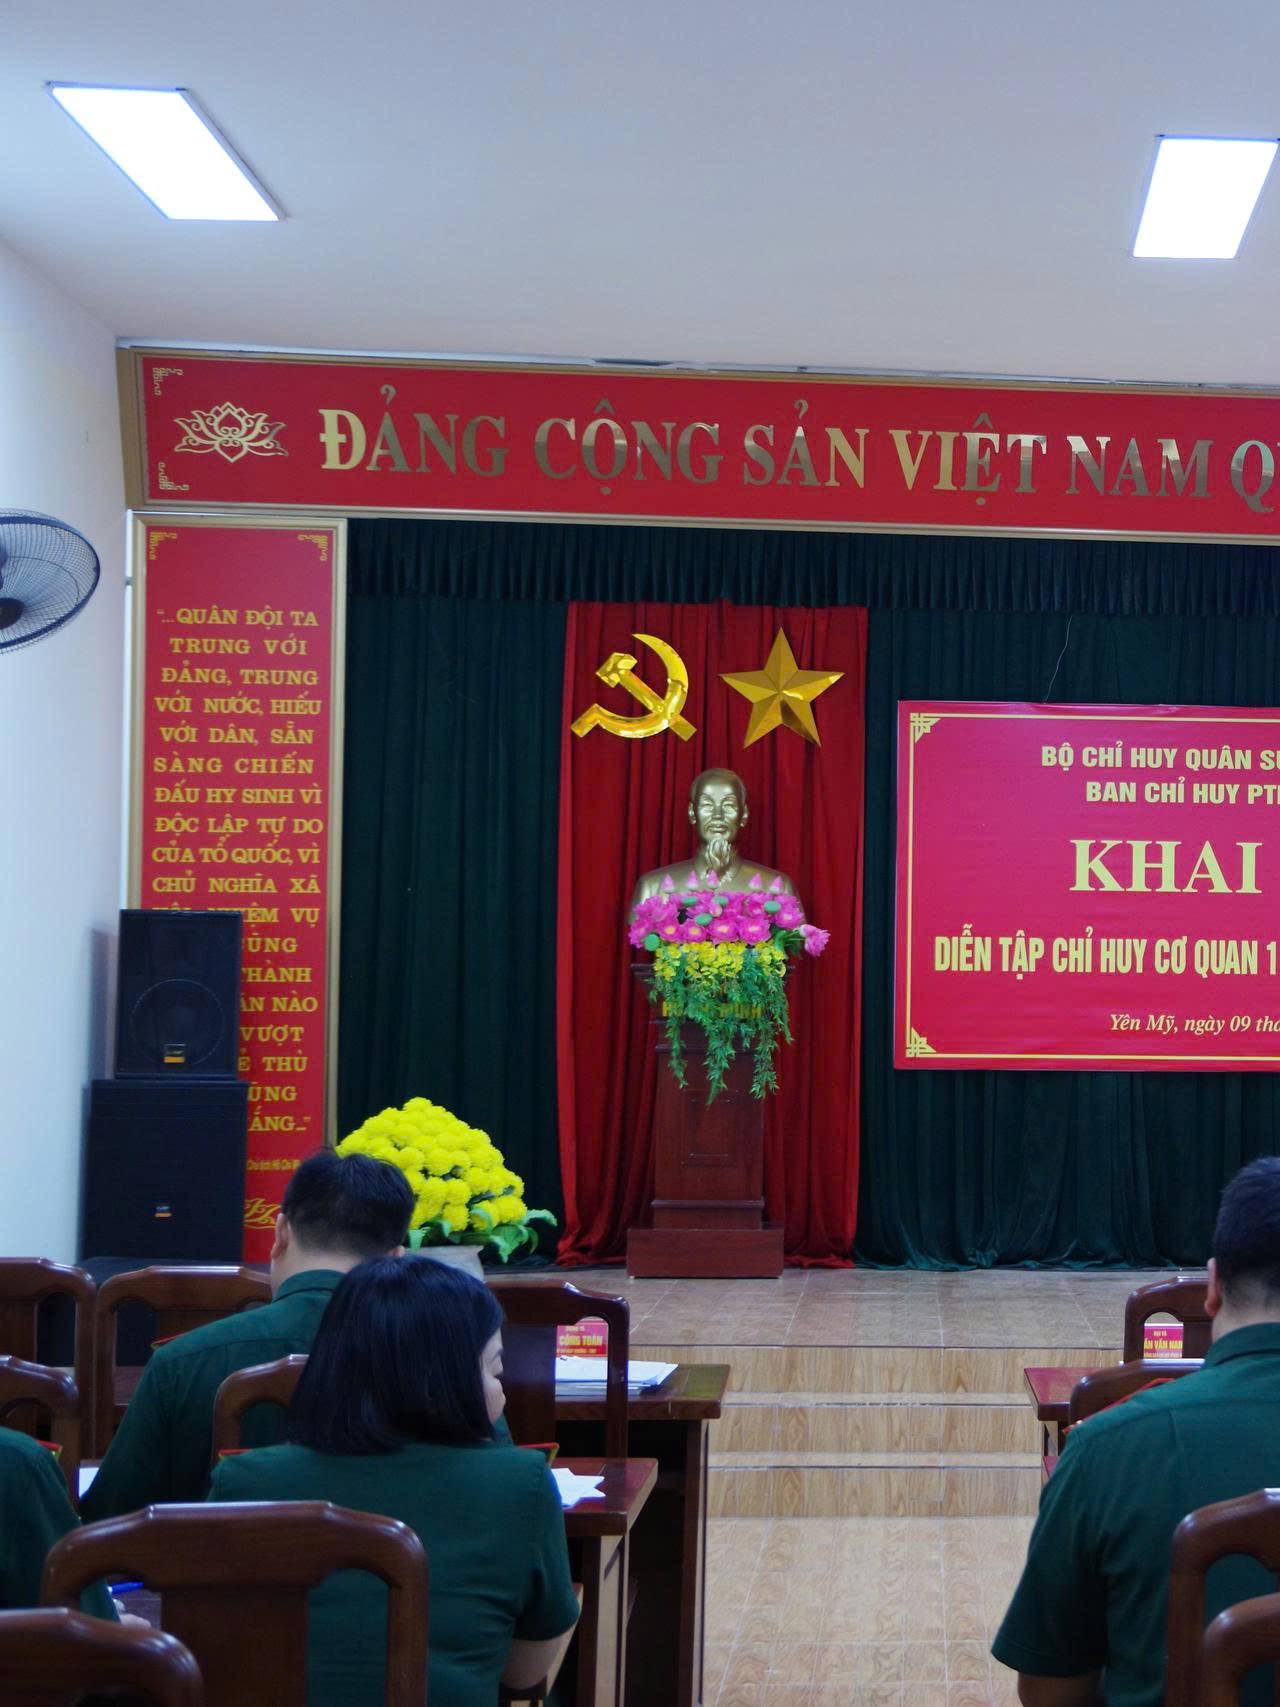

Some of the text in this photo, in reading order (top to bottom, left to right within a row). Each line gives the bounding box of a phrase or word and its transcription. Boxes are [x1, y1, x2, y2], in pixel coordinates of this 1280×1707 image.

[319, 384, 510, 476] ĐẢNG
[534, 398, 725, 495] CỘNG
[744, 399, 869, 489] SẢN
[889, 412, 1047, 505] VIỆT
[1066, 435, 1214, 498] NAM
[246, 605, 283, 629] ĐỘI
[290, 610, 318, 626] TA
[170, 633, 306, 655] TRUNG VỚI
[161, 660, 318, 685] ĐẢNG, TRUNG
[154, 690, 321, 715] VỚI NƯỚC, HIẾU
[160, 720, 314, 745] VỚI DÂN, SẴN
[153, 751, 314, 774] SÀNG CHIẾN
[1042, 742, 1073, 770] BỘ
[1082, 740, 1122, 769] CHỈ
[1131, 748, 1177, 769] HUY
[1186, 745, 1252, 770] QUÂN
[155, 779, 322, 804] ĐẤU HY SINH VÌ
[1086, 781, 1136, 802] BAN
[1145, 776, 1185, 803] CHỈ
[1193, 784, 1239, 804] HUY
[156, 813, 199, 836] ĐỘC
[257, 816, 286, 837] TỰ
[293, 818, 323, 834] DO
[152, 840, 195, 862] CỦA
[232, 839, 293, 865] QUỐC,
[298, 842, 320, 863] VÌ
[1069, 839, 1262, 893] KHAI
[152, 870, 320, 893] CHỦ NGHĨA XÃ
[290, 908, 320, 927] VỤ
[243, 932, 298, 952] ŨNG
[935, 924, 991, 971] DIỄN
[999, 930, 1044, 980] TẬP
[1053, 926, 1093, 973] CHỈ
[1100, 939, 1147, 973] HUY
[1155, 936, 1187, 974] CƠ
[1195, 940, 1257, 978] QUAN
[1267, 942, 1276, 974] 1
[242, 960, 312, 982] HÀNH
[272, 990, 318, 1012] NÀO
[240, 1024, 304, 1046] VƯỢT
[1110, 1014, 1143, 1031] Yên
[1146, 1015, 1178, 1034] Mỹ,
[1184, 1016, 1224, 1034] ngày
[1230, 1016, 1250, 1032] 09
[262, 1049, 308, 1071] THÙ
[248, 1081, 297, 1101] ŨNG
